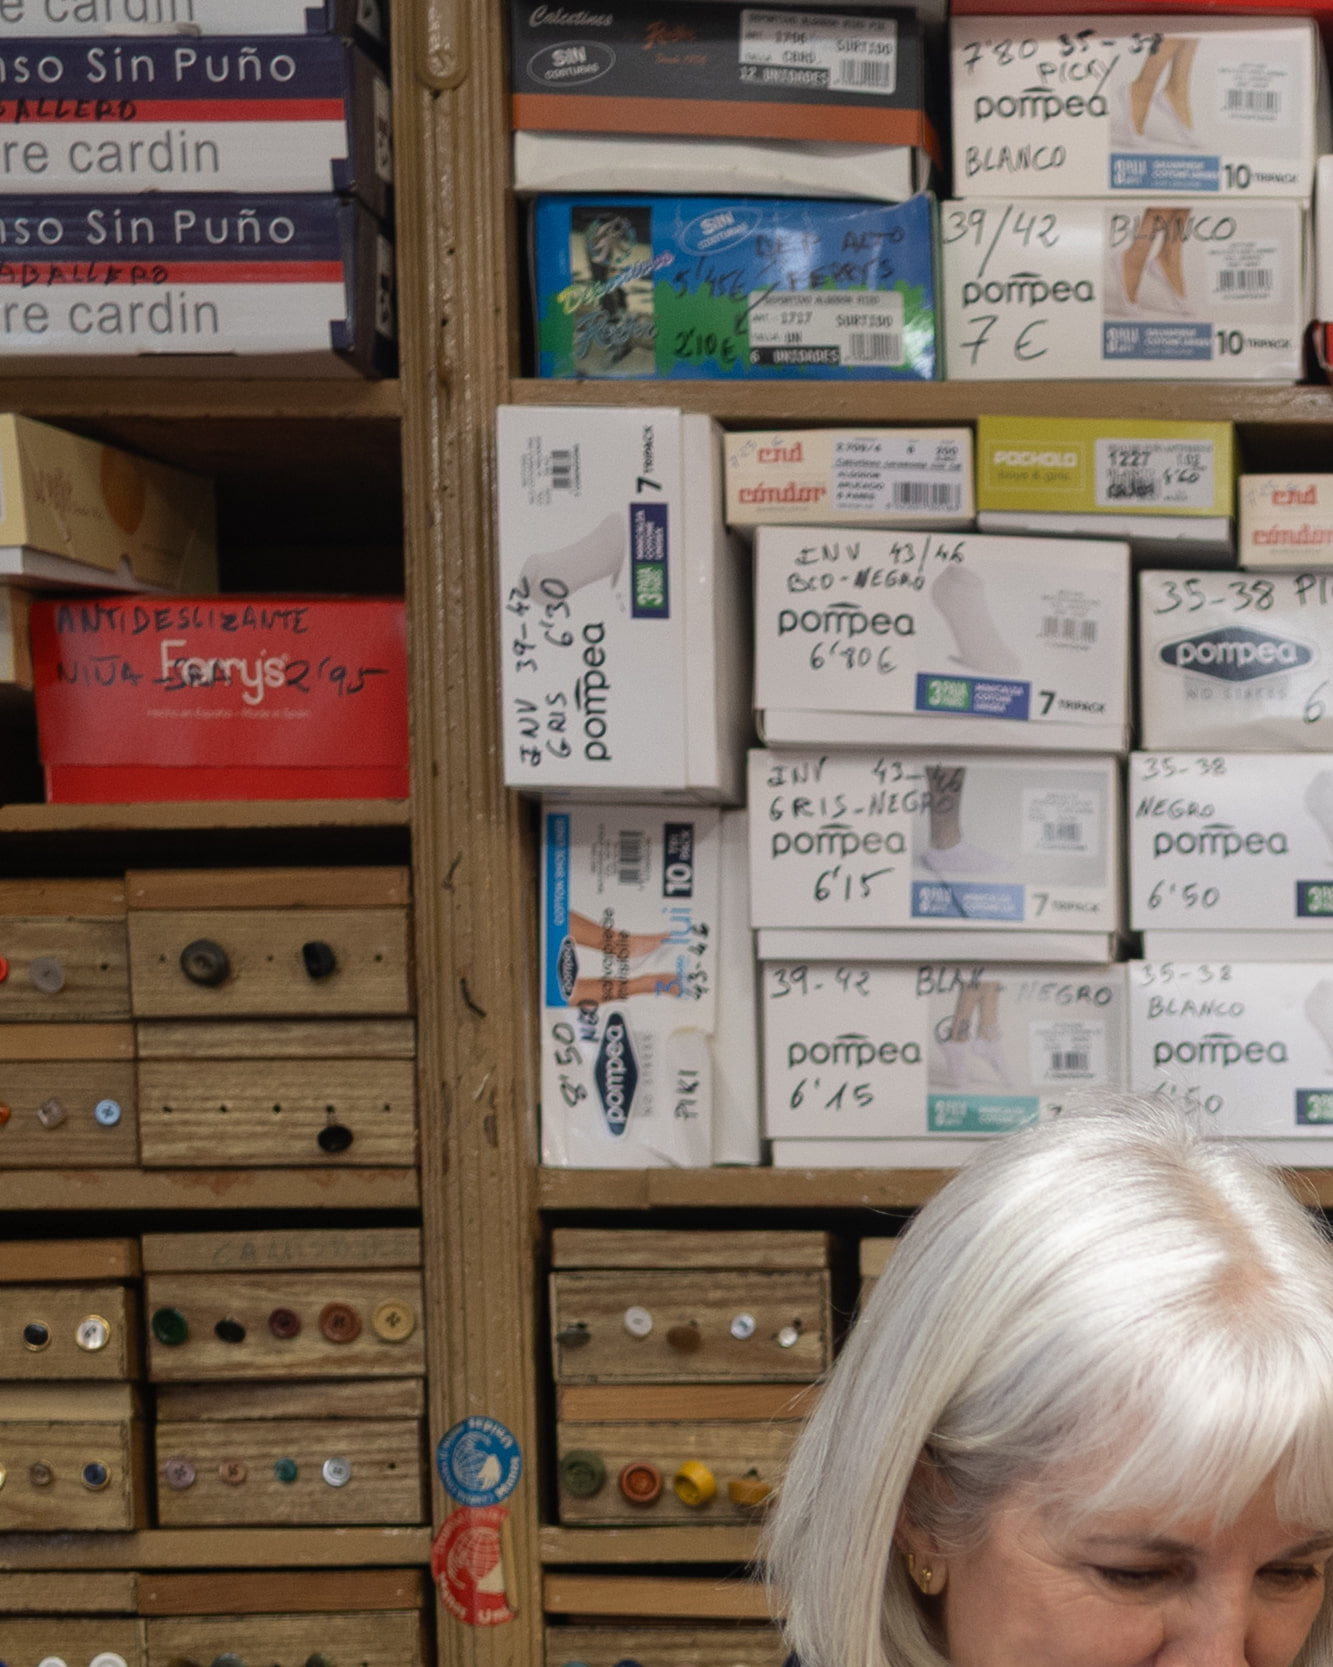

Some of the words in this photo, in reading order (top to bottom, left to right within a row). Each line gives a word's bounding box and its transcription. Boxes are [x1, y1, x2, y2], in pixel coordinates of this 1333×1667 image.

[87, 48, 155, 82] Sin
[175, 47, 297, 82] Puño
[973, 86, 1110, 123] pompea
[69, 130, 219, 173] cardin
[965, 145, 1067, 177] BLANCO
[1223, 164, 1251, 189] 10
[87, 210, 155, 245] Sin
[174, 209, 295, 245] Puño
[1109, 214, 1237, 248] BLANCO
[962, 272, 1095, 308] pompea
[69, 292, 219, 334] cardin
[1216, 330, 1244, 356] 10
[993, 450, 1078, 467] POCHOLO
[636, 476, 662, 494] 7
[778, 601, 915, 638] pompea
[1176, 640, 1298, 665] pompea
[159, 639, 287, 706] Ferrys
[575, 621, 612, 762] pompea
[1038, 691, 1056, 716] 7
[1135, 798, 1215, 819] NEGRO
[771, 823, 907, 860] pompea
[1153, 822, 1289, 858] pompea
[665, 863, 692, 894] 10
[1147, 995, 1244, 1020] BLANCO
[787, 1033, 922, 1069] pompea
[1153, 1032, 1288, 1068] pompea
[604, 1024, 626, 1124] pompea
